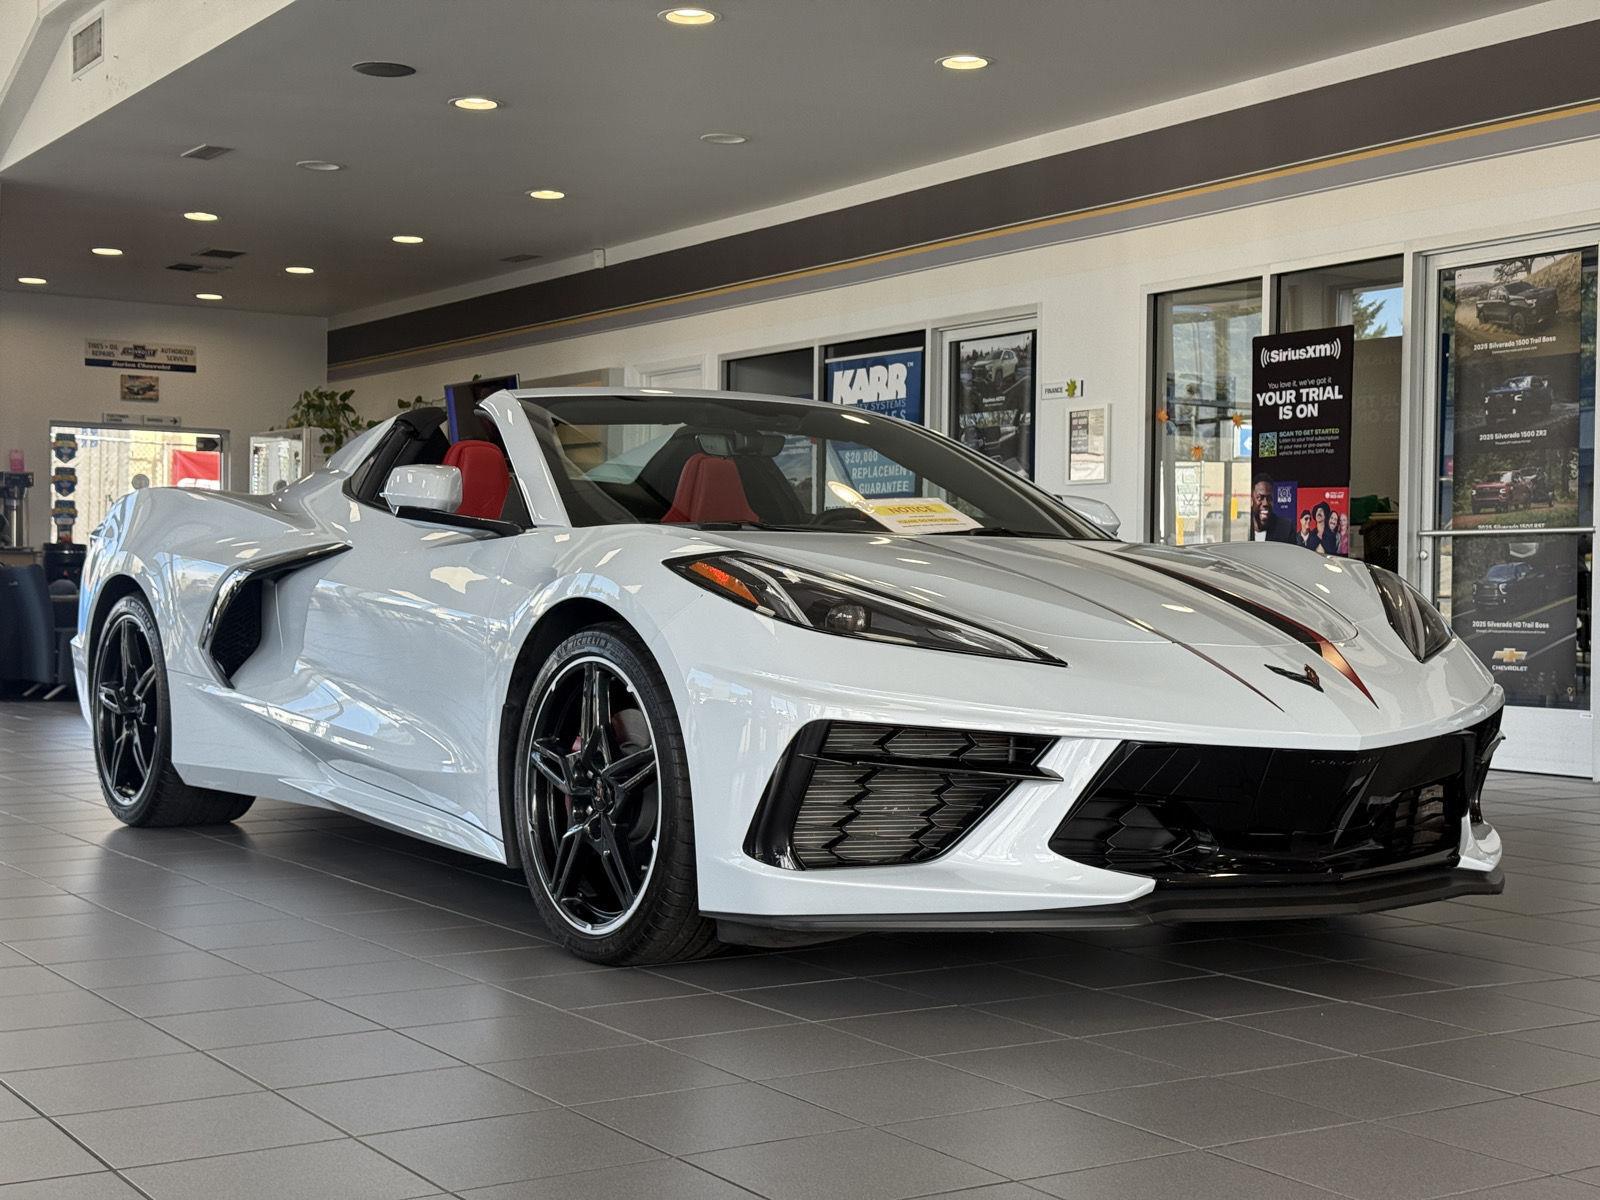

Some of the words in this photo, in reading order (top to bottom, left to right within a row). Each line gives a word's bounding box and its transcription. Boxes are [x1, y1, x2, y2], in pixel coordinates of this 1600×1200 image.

[1488, 341, 1515, 350] Silverado
[1516, 338, 1530, 346] 1500
[1530, 336, 1541, 344] Trail
[832, 363, 907, 405] KARR
[1256, 390, 1296, 406] YOUR
[1300, 385, 1344, 402] TRIAL
[870, 400, 906, 410] SYSTEMS
[1279, 405, 1292, 420] IS
[1296, 402, 1318, 420] ON
[1494, 432, 1520, 440] Silverado
[845, 450, 878, 464] $20,000
[860, 480, 909, 494] GUARANTEE
[1472, 620, 1486, 628] 2025
[1487, 620, 1512, 628] Silverado
